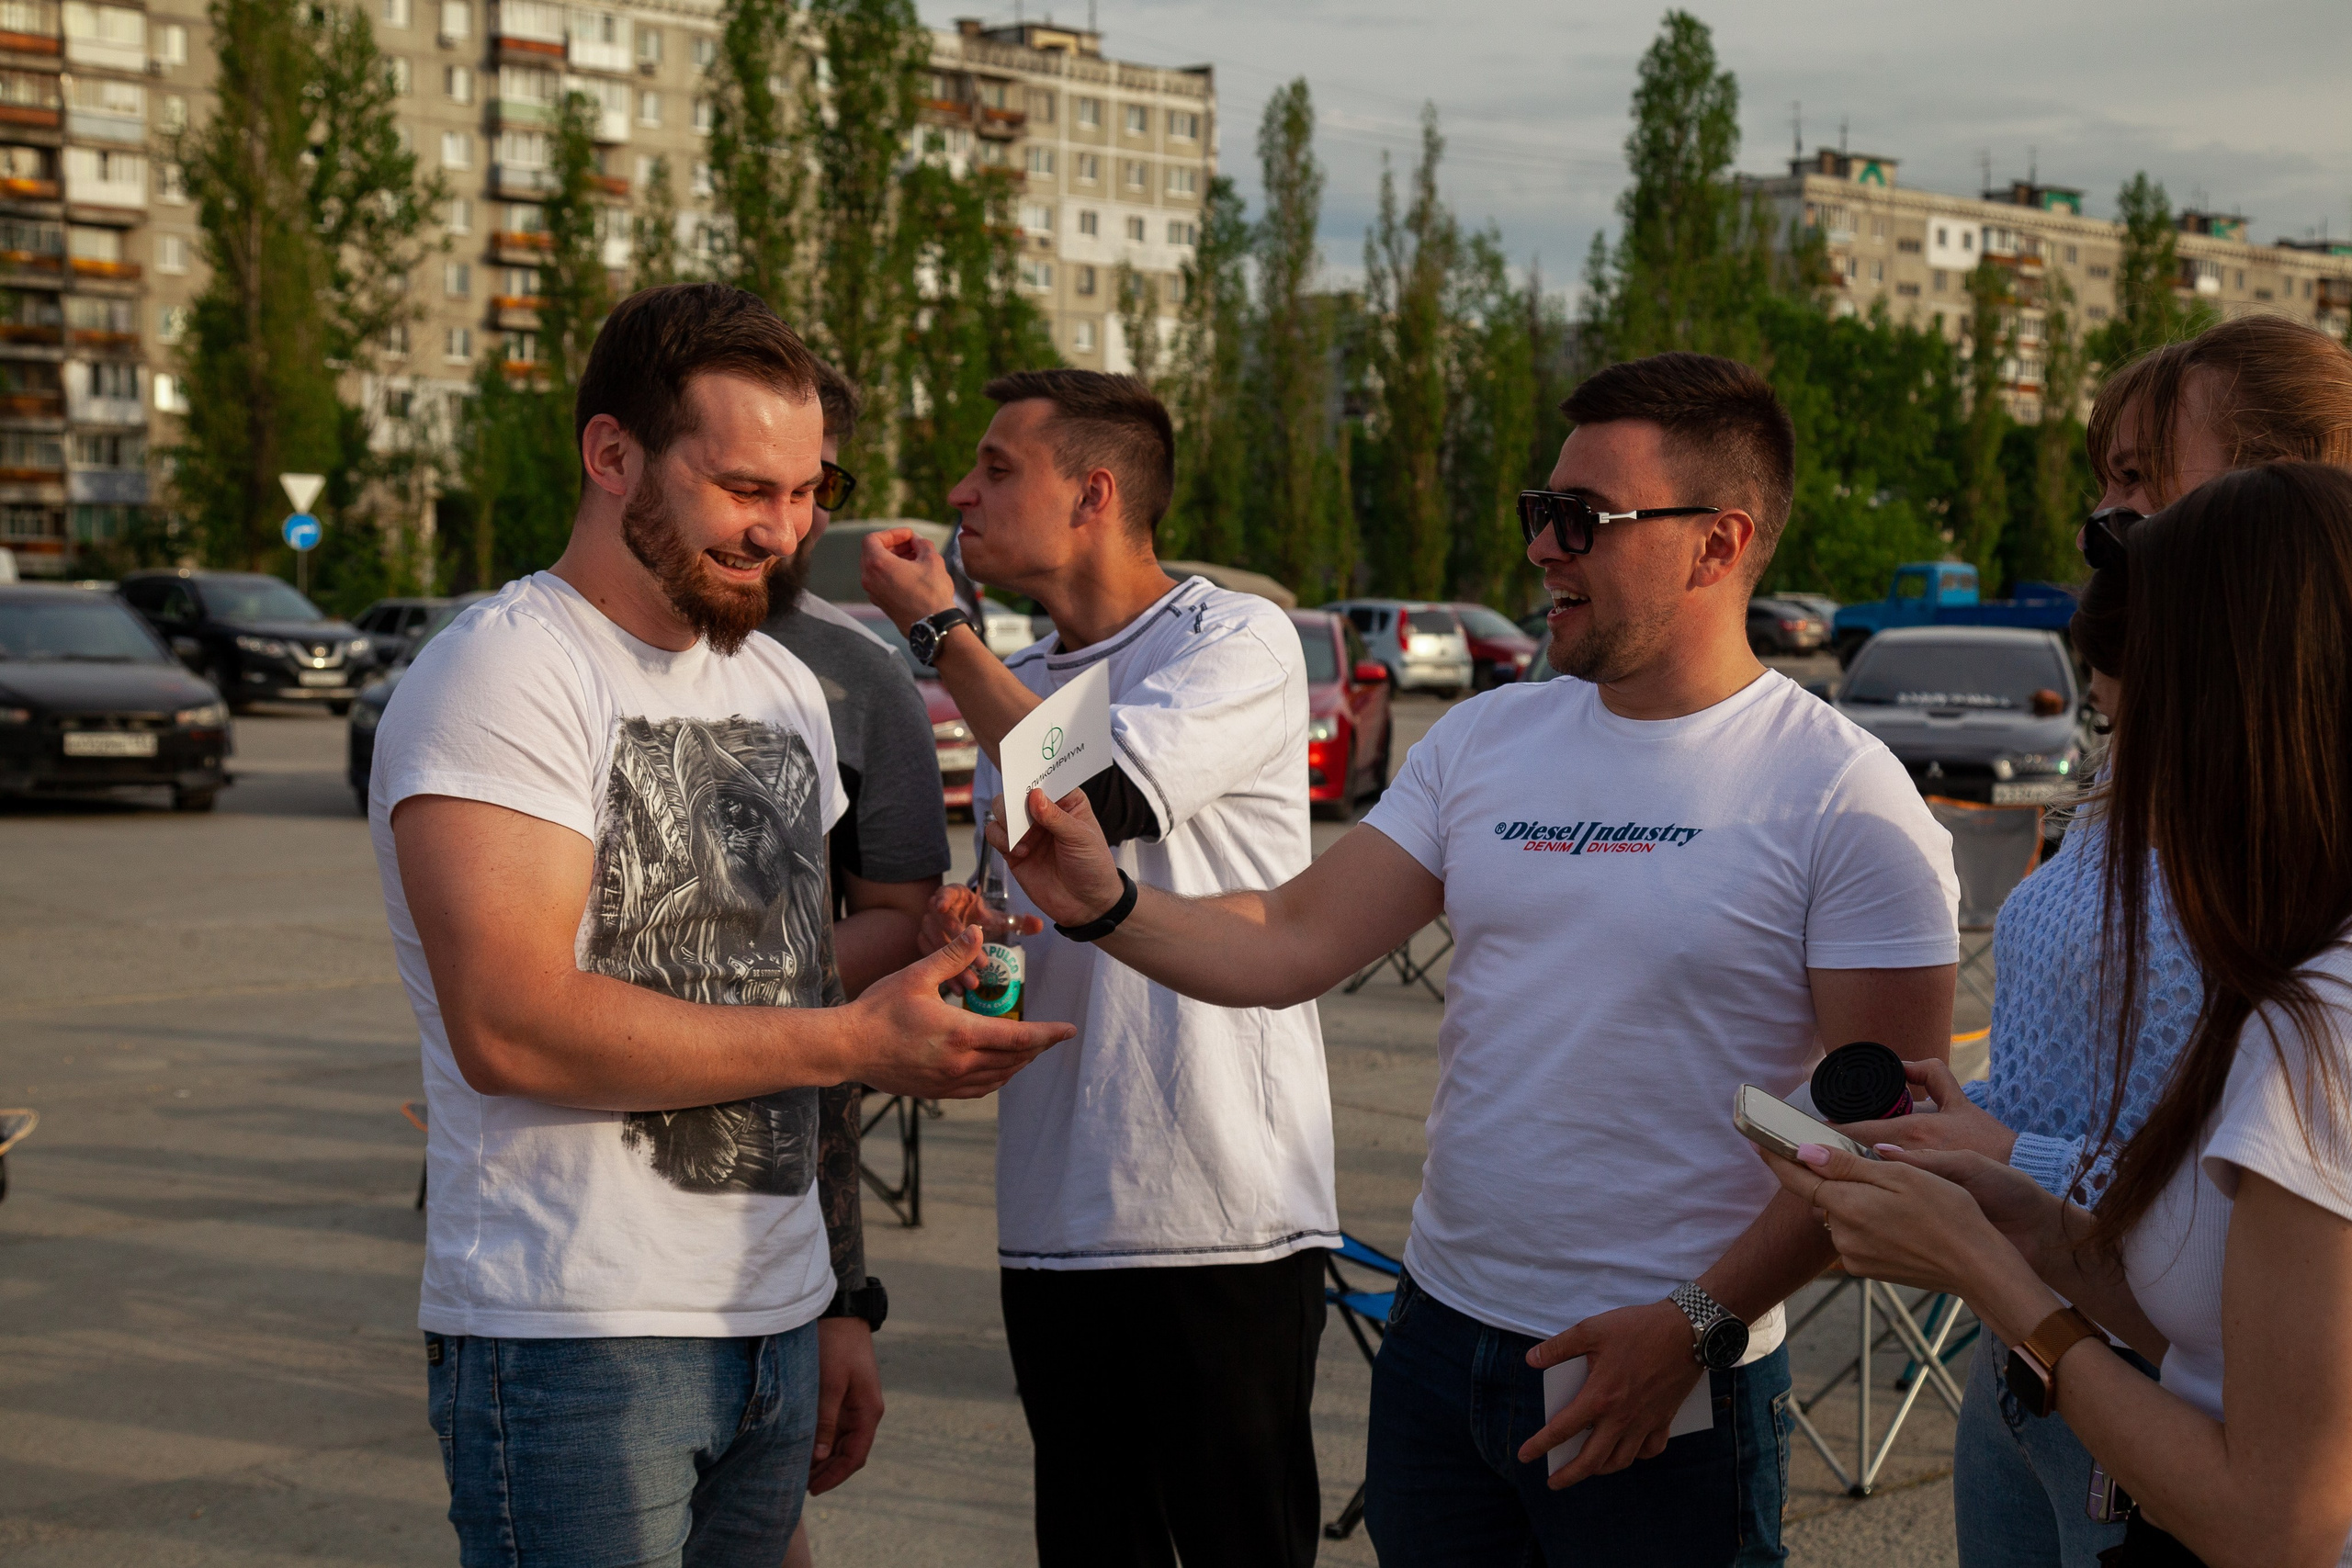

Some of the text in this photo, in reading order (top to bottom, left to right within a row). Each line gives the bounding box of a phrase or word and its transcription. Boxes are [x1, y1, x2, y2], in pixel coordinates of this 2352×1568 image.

[1522, 840, 1656, 853] DENIM DIVISION
[1570, 821, 1703, 855] Industry
